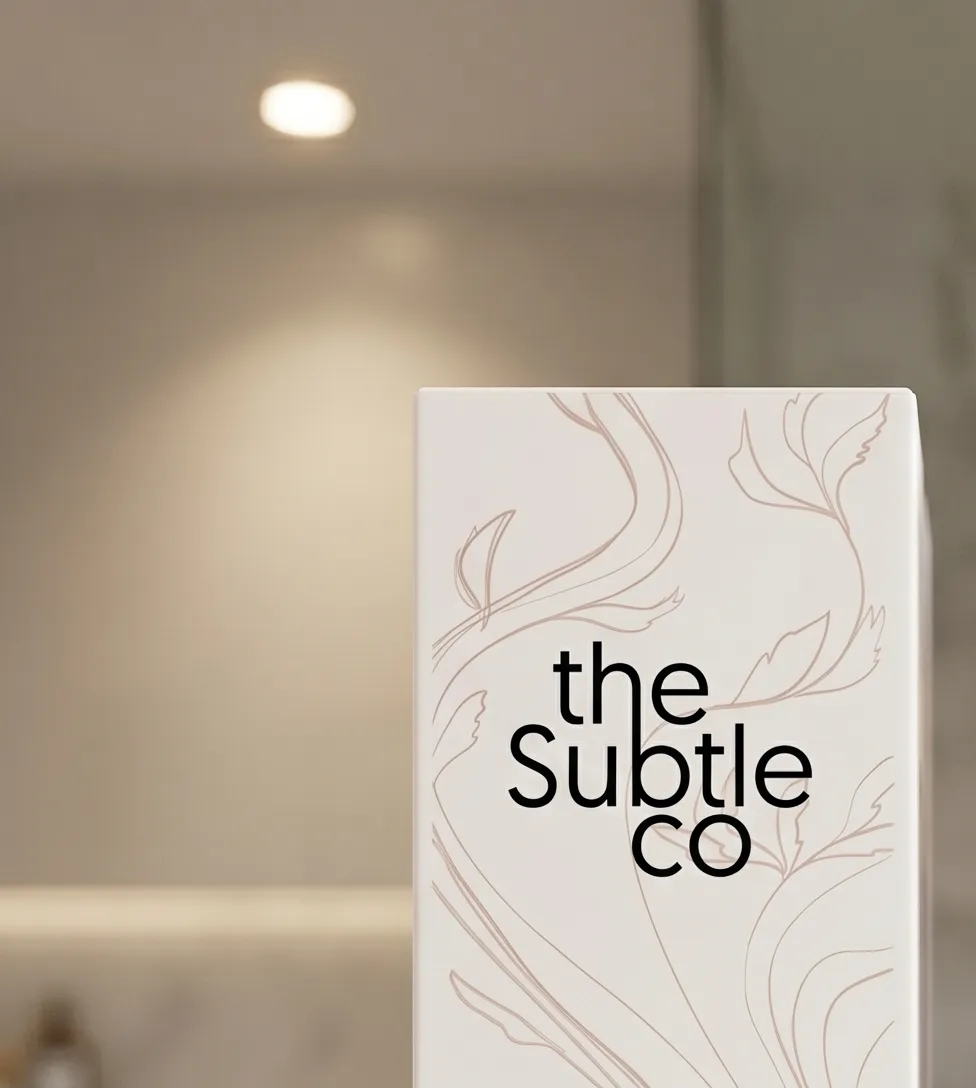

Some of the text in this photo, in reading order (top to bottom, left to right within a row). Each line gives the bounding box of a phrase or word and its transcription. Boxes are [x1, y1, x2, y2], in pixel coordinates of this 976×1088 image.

[552, 640, 709, 726] the
[508, 722, 813, 809] Subtle
[631, 813, 752, 879] co
